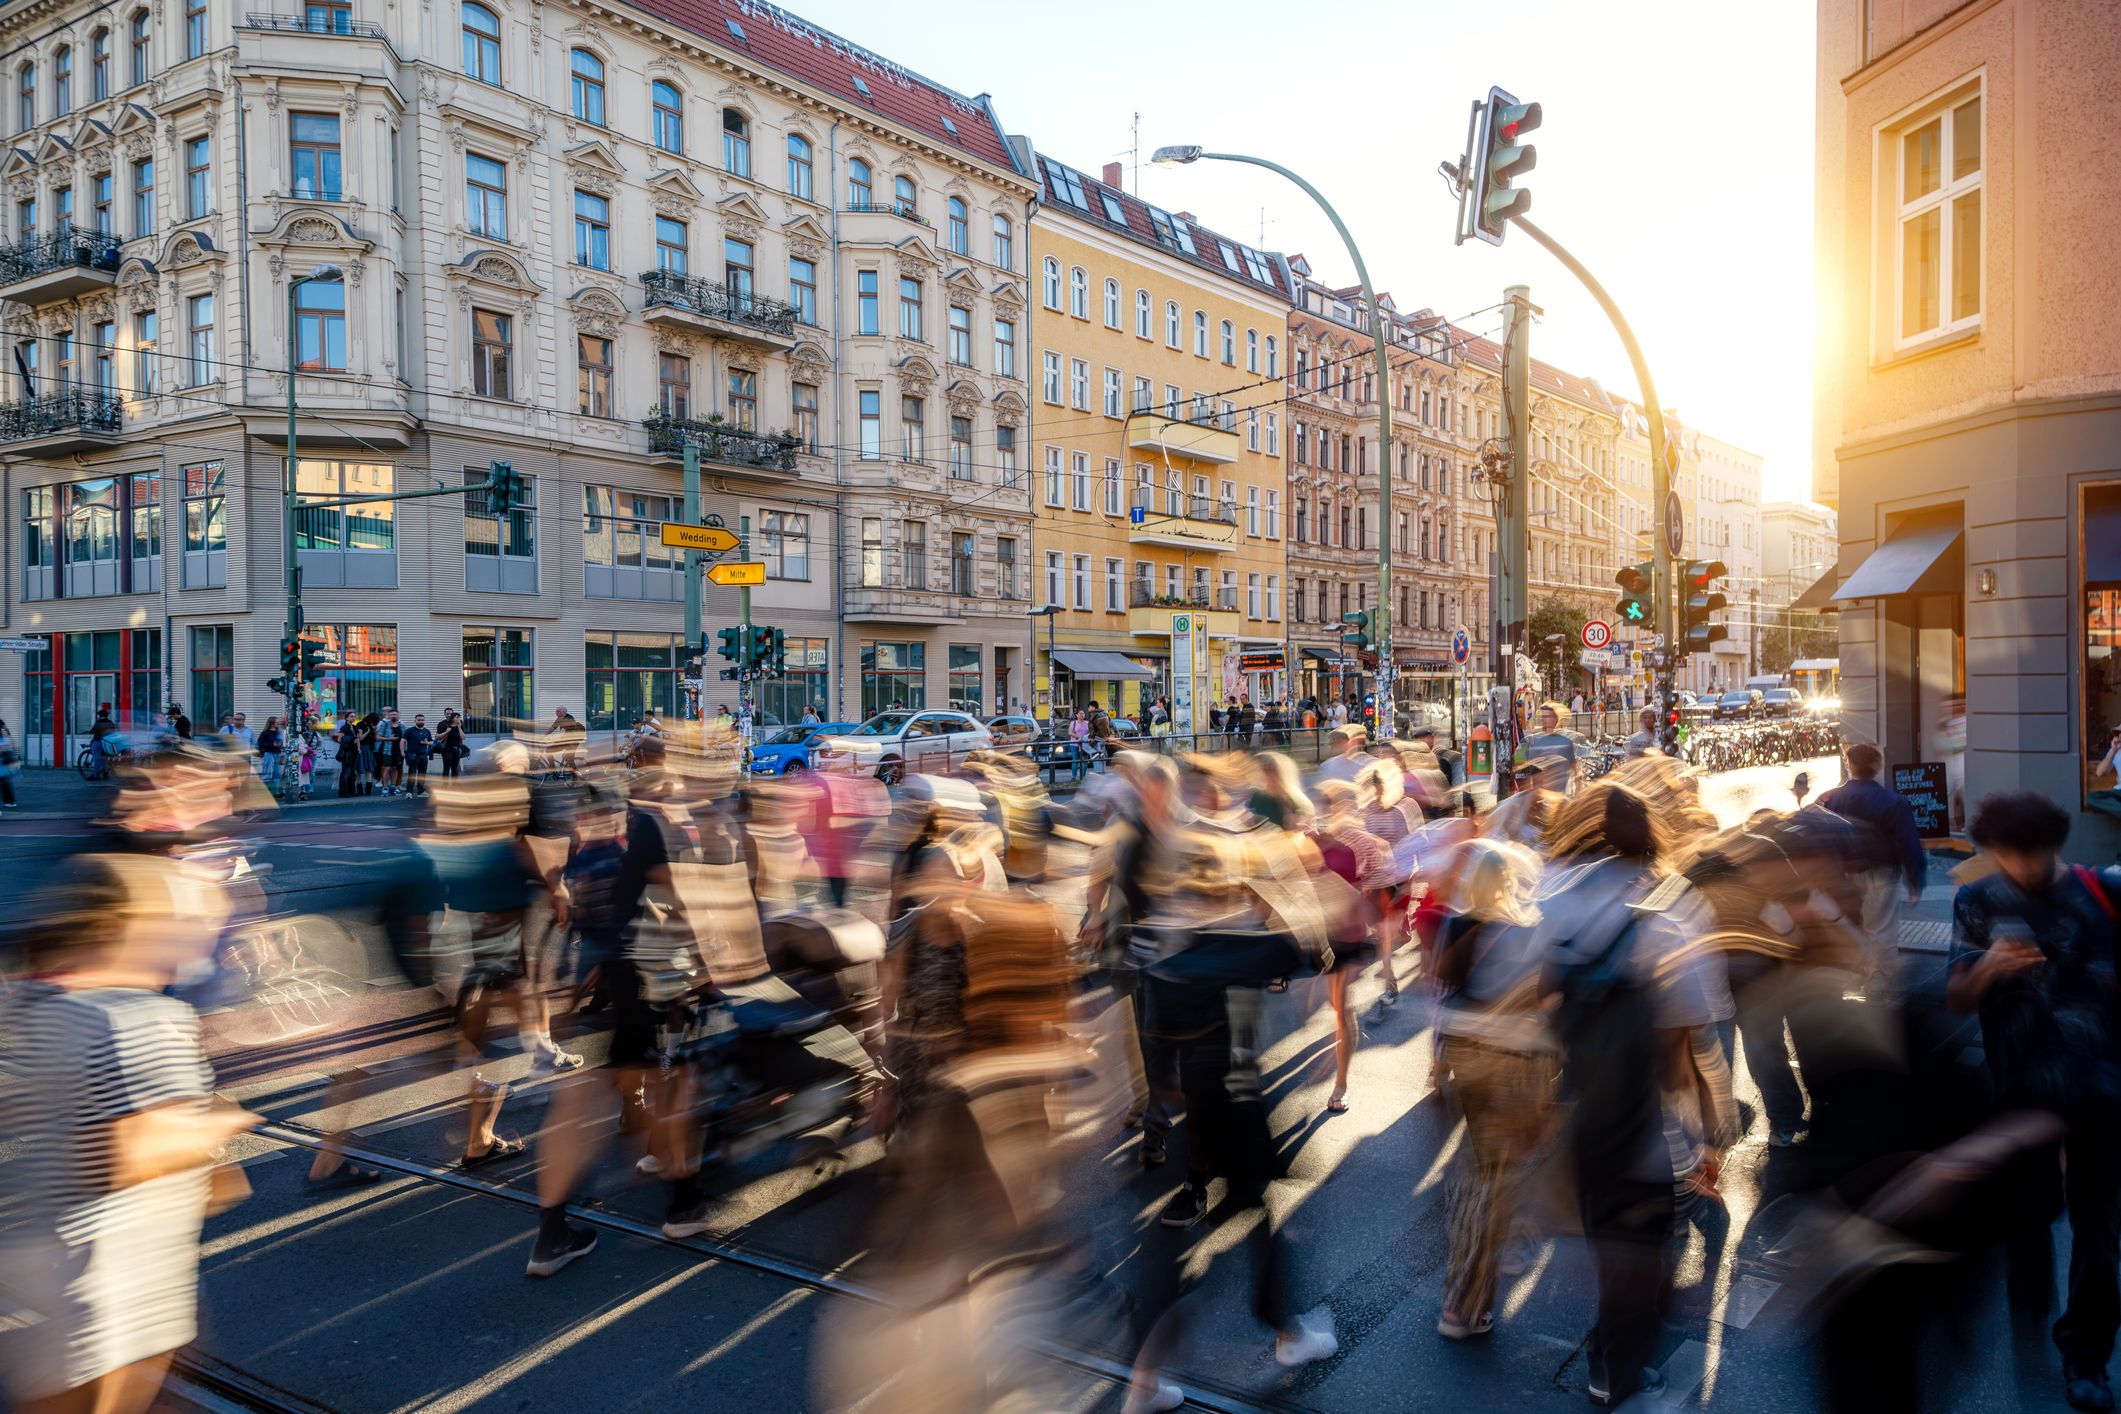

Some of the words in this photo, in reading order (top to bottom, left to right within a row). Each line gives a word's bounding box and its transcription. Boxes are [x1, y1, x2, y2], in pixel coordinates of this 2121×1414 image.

[1133, 508, 1142, 522] T
[679, 531, 717, 546] Wedding
[729, 570, 746, 579] Mitte
[1588, 628, 1605, 641] 30
